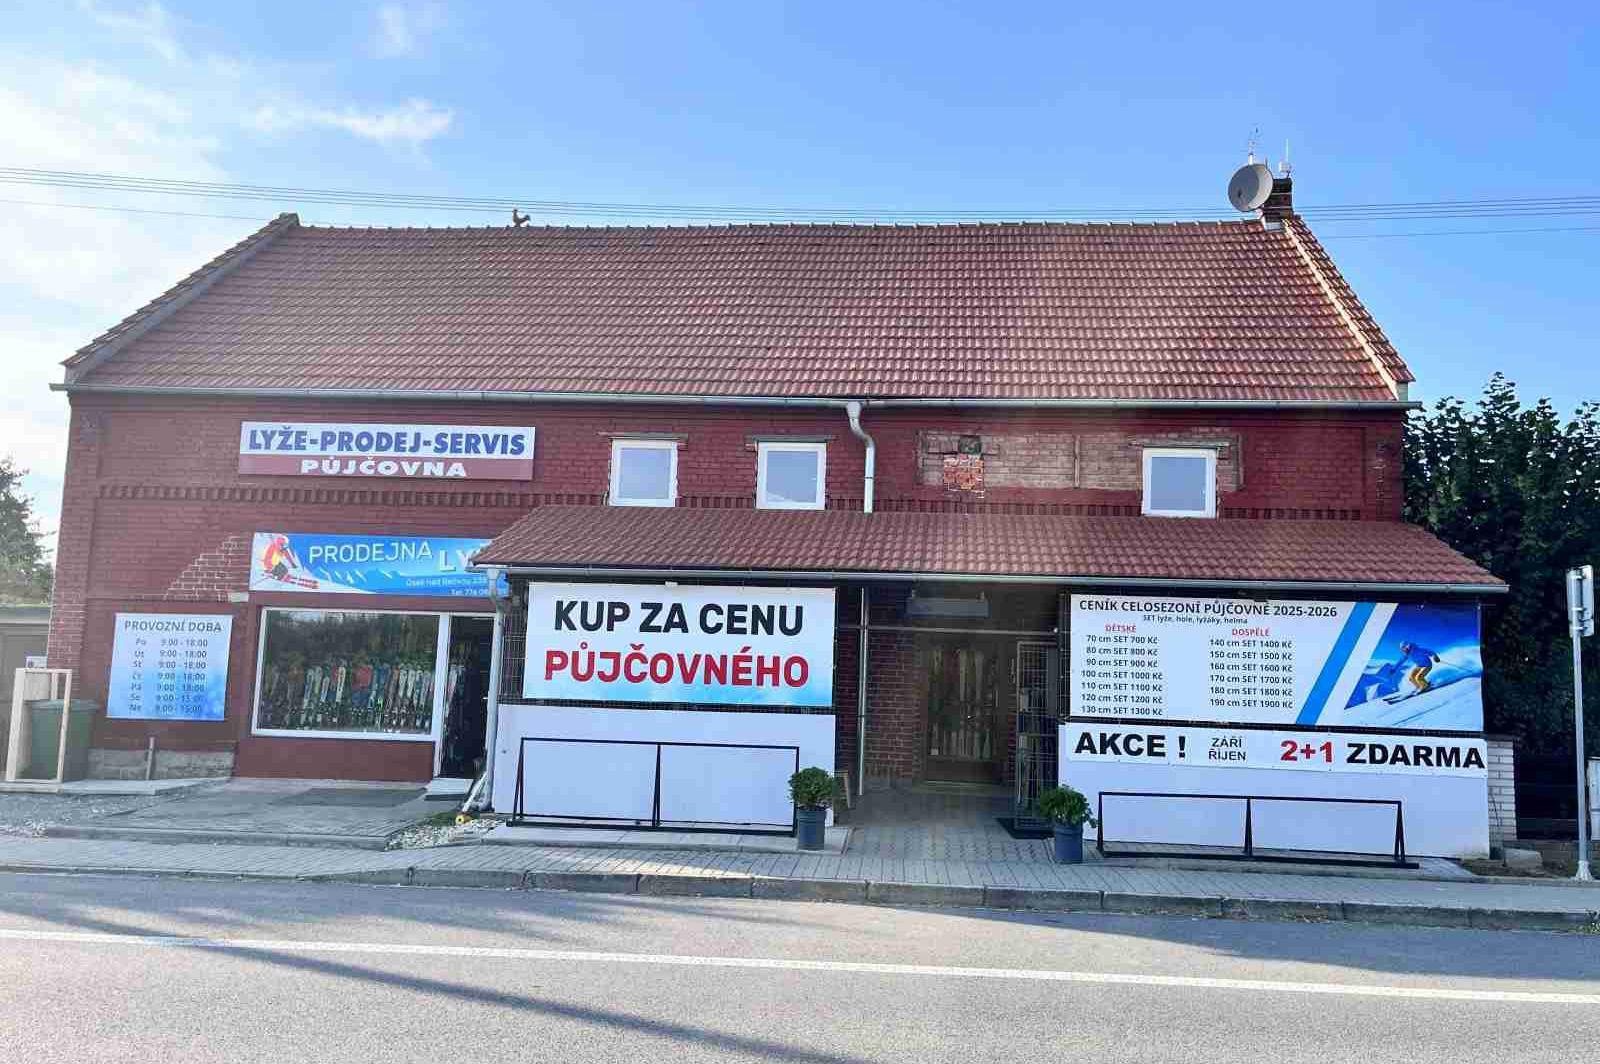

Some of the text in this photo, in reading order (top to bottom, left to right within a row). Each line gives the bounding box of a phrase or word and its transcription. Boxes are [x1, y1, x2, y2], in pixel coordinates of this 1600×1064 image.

[249, 426, 525, 455] LYŽE-PRODEJ-SERVIS
[300, 456, 467, 478] PŮJČOVNA
[308, 541, 433, 564] PRODEJNA
[1079, 598, 1338, 617] CENÍK CELOSEZONÍ PŮJČOVNÉ 2025-2026
[554, 600, 804, 636] KUP ZA CENU
[125, 620, 221, 633] PROVOZNÍ DOBA
[1113, 636, 1128, 644] SET
[1210, 639, 1224, 647] 140
[1260, 640, 1280, 648] 1400
[1210, 651, 1224, 659] 150
[1260, 652, 1280, 660] 1500
[544, 641, 810, 688] PŮJČOVNÉHO
[1210, 663, 1224, 671] 160
[1260, 664, 1280, 672] 1600
[1210, 675, 1224, 683] 170
[1260, 676, 1280, 684] 1700
[1113, 683, 1128, 691] SET
[1210, 687, 1224, 695] 180
[1260, 688, 1280, 696] 1800
[1113, 695, 1128, 703] SET
[1210, 699, 1224, 707] 190
[1260, 700, 1280, 708] 1900
[1113, 707, 1128, 715] SET
[1074, 731, 1186, 758] AKCE !
[1212, 735, 1242, 748] ZÁŘÍ
[1279, 740, 1486, 769] 2+1 ZDARMA
